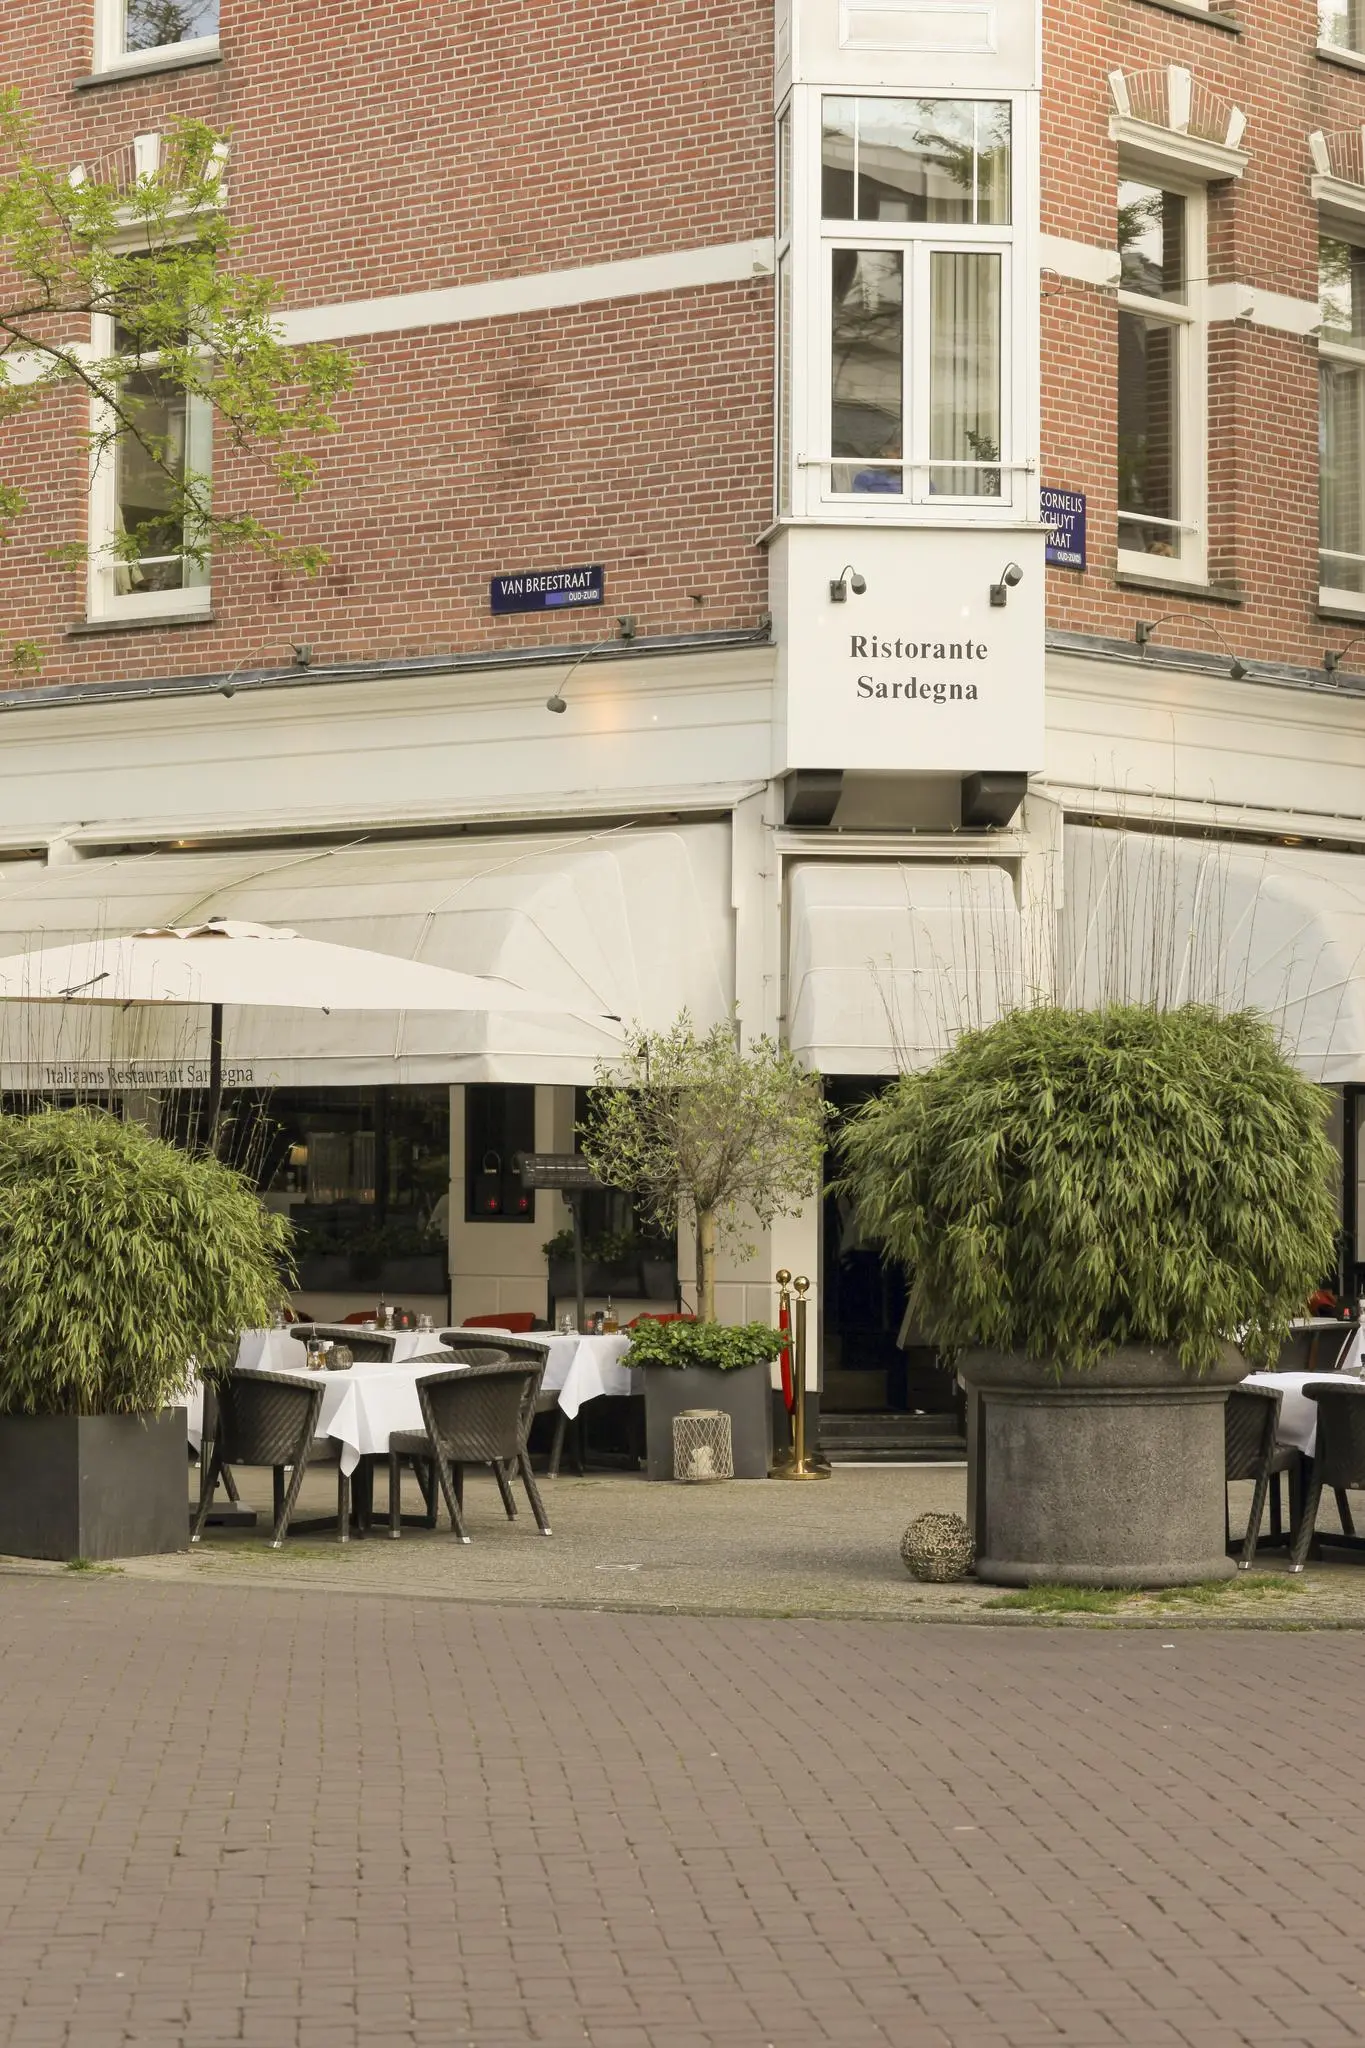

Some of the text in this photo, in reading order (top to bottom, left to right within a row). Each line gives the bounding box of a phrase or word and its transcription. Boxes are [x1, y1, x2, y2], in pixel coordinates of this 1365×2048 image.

[1040, 491, 1083, 513] CORNELIS
[1040, 510, 1075, 530] SCHUYT
[1045, 532, 1072, 549] TRAAT
[501, 571, 592, 595] VAN BREESTRAAT
[568, 590, 598, 601] OUD-ZUID
[849, 635, 988, 660] Ristorante
[857, 675, 978, 704] Sardegna
[46, 1065, 254, 1087] Italiaans Restaurant Saregna
